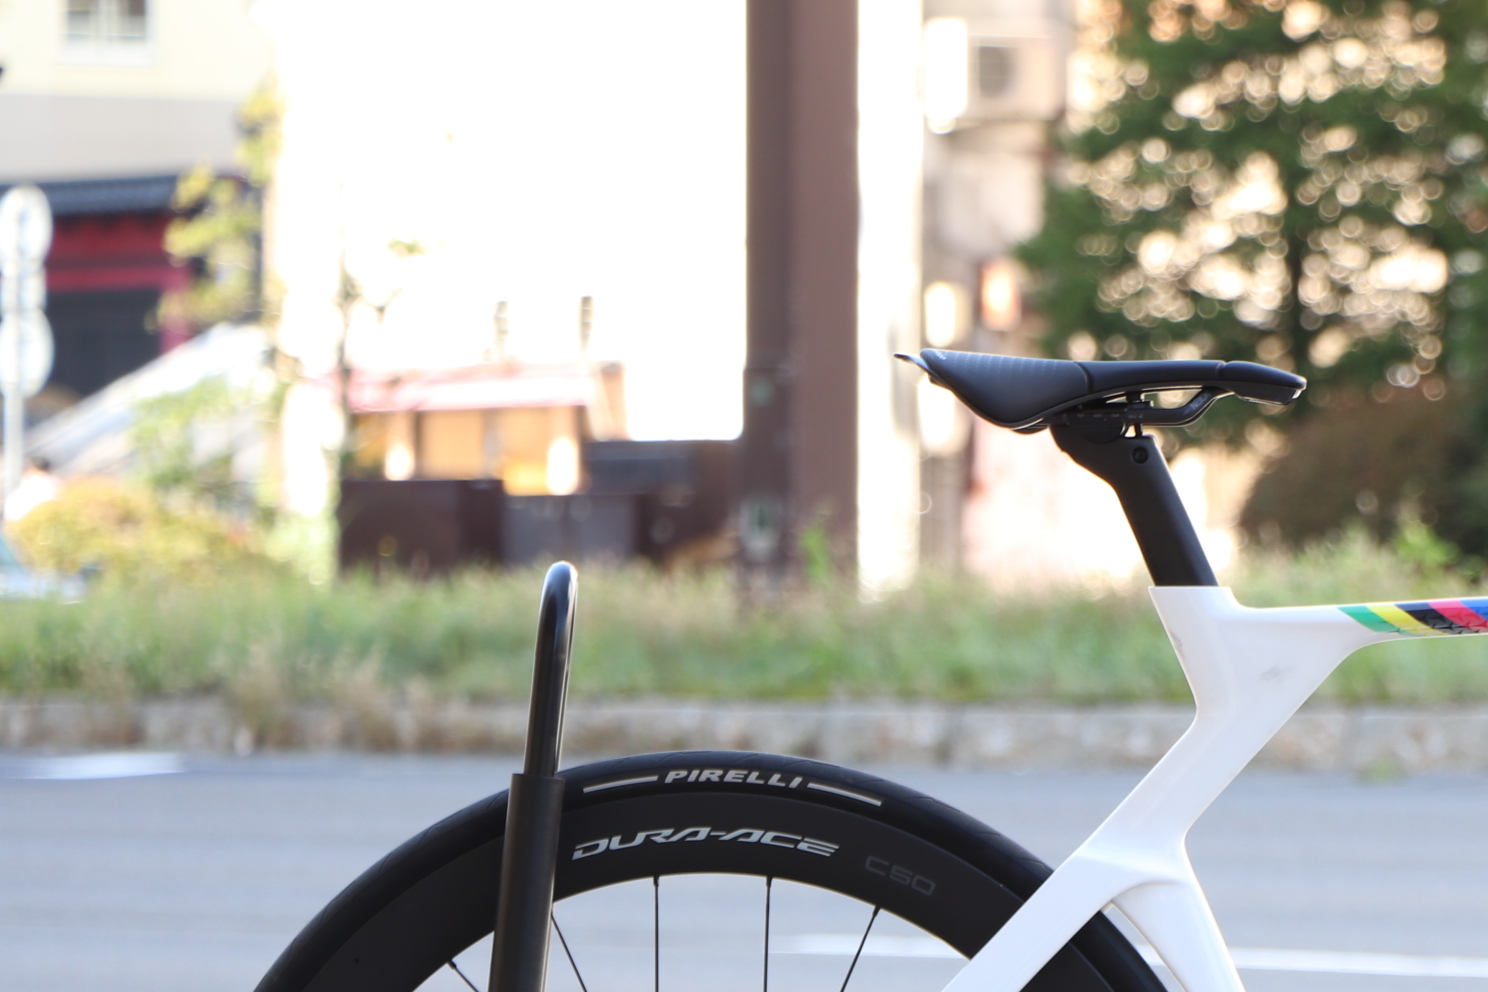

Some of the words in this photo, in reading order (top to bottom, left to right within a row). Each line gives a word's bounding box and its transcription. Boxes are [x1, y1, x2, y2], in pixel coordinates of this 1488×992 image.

[665, 769, 803, 789] PIRELLI
[572, 826, 840, 860] DURA-ACE
[865, 856, 935, 896] C50
